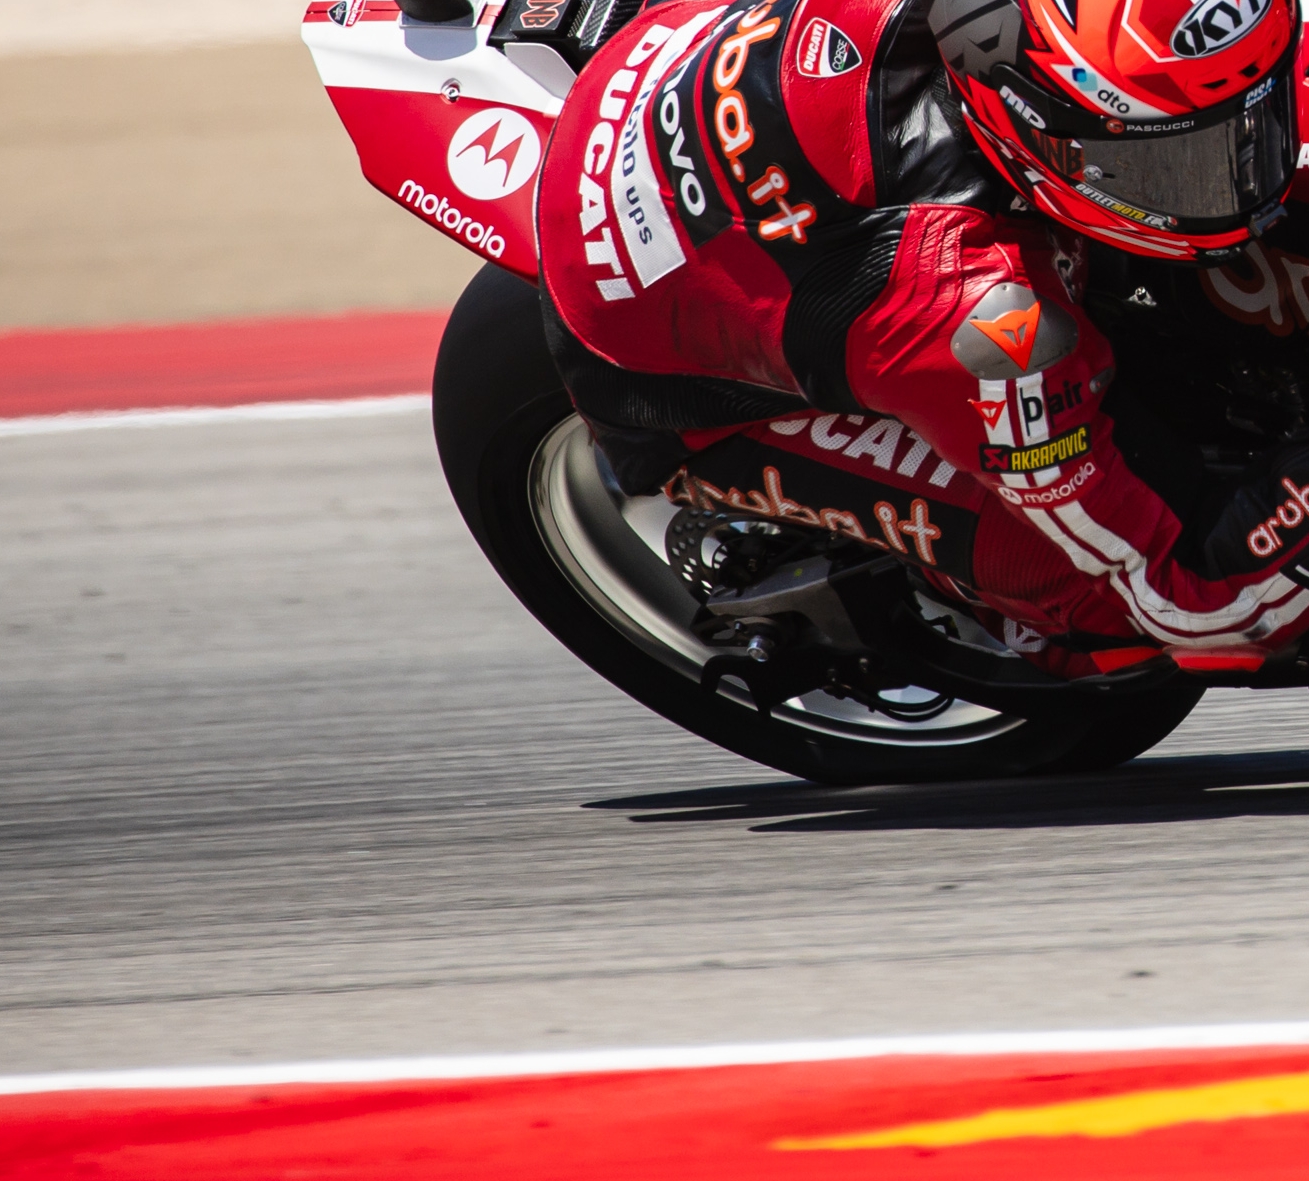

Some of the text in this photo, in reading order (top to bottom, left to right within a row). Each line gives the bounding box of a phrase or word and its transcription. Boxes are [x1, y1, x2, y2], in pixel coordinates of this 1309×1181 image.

[803, 23, 827, 72] DUCATI
[832, 38, 849, 71] CORSE
[1097, 89, 1130, 114] dto
[1126, 120, 1195, 132] PASCUCCI
[578, 23, 676, 302] DUCATI
[398, 179, 506, 259] motorola
[624, 186, 653, 246] ups
[769, 413, 957, 489] CATI
[1024, 461, 1097, 505] motorola
